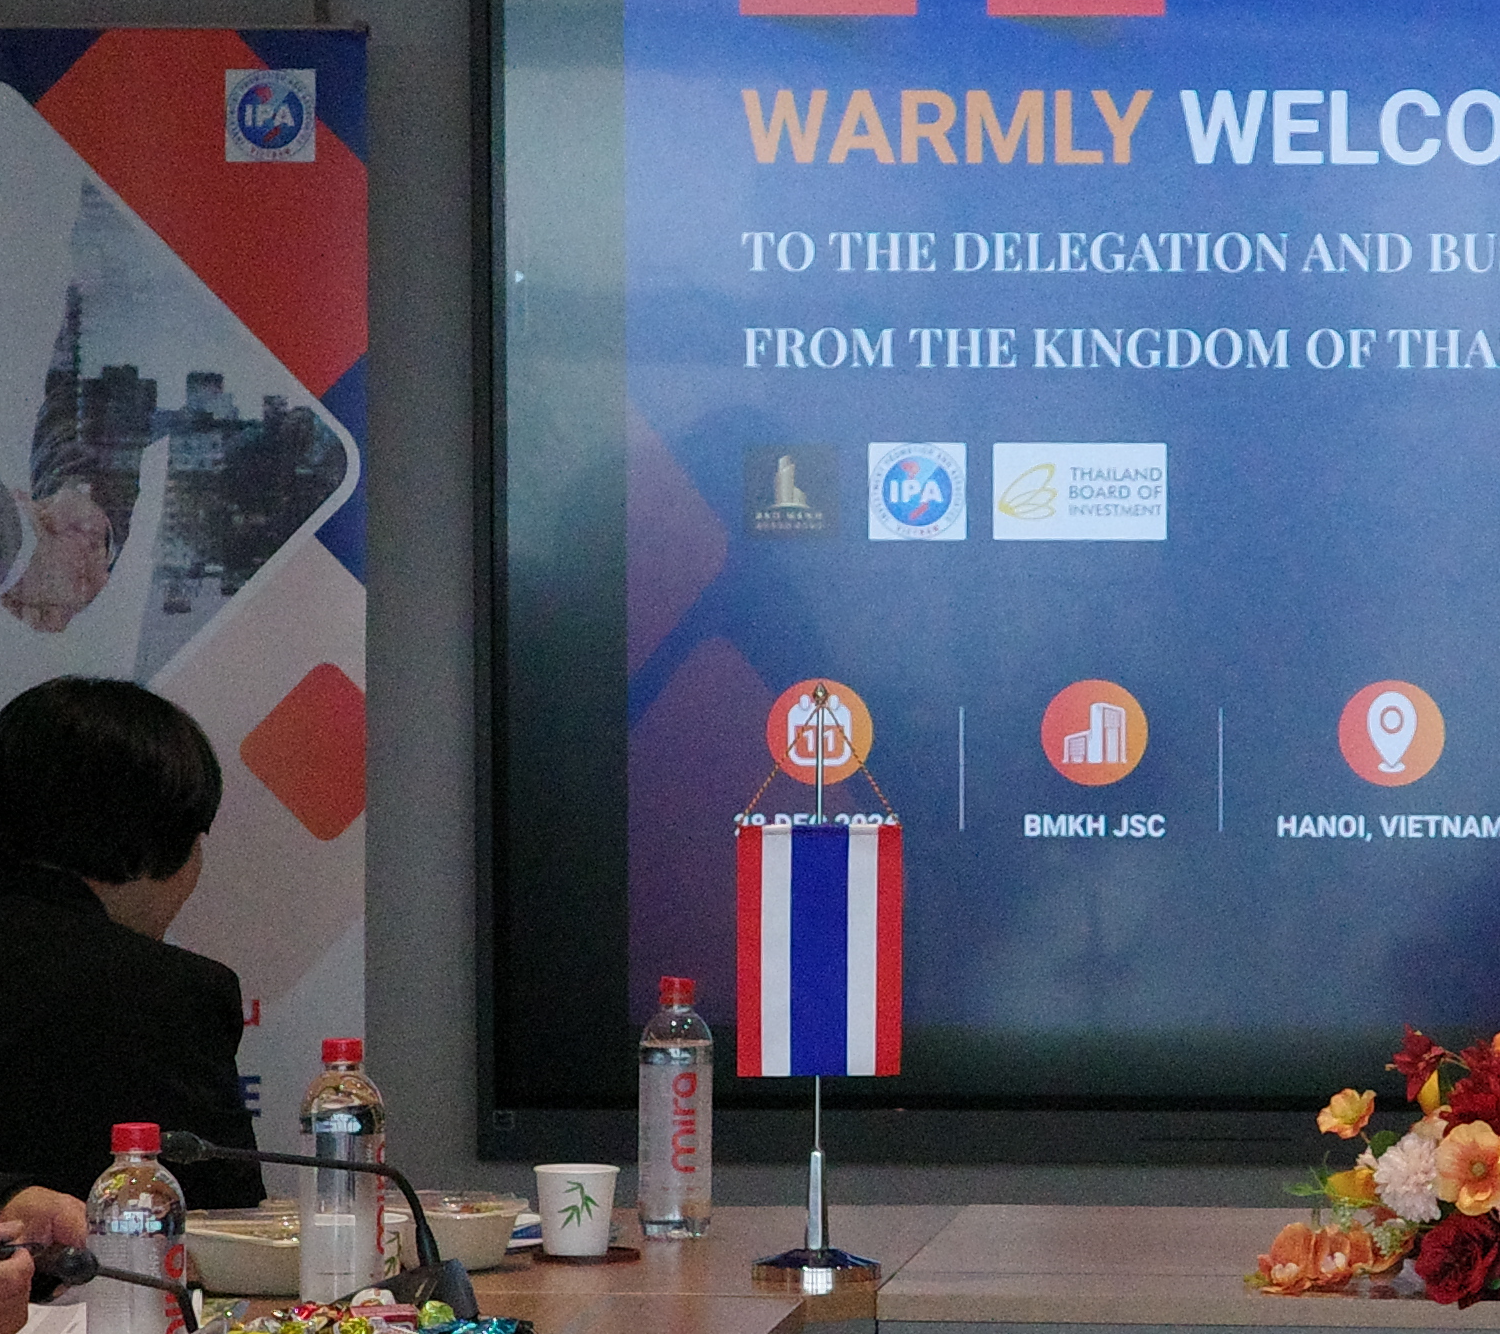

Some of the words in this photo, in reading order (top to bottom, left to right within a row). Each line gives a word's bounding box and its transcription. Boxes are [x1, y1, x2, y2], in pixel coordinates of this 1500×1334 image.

[245, 103, 296, 127] IPA
[741, 89, 1153, 165] WARMLY
[742, 231, 816, 273] TO
[828, 231, 936, 273] THE
[953, 231, 1289, 273] DELEGATION
[1303, 231, 1414, 273] AND
[743, 327, 896, 369] FROM
[909, 327, 1017, 369] THE
[1033, 327, 1290, 369] KINGDOM
[1306, 327, 1376, 369] OF
[1069, 466, 1163, 482] THAILAND
[889, 478, 944, 504] IPA
[1068, 484, 1132, 500] BOARD
[1137, 484, 1163, 500] OF
[1068, 503, 1162, 517] INVESTMENT
[802, 729, 836, 753] 11
[1024, 813, 1105, 837] BMKH
[1113, 813, 1166, 838] JSC
[1277, 814, 1373, 843] HANOI,
[671, 1071, 698, 1174] mira
